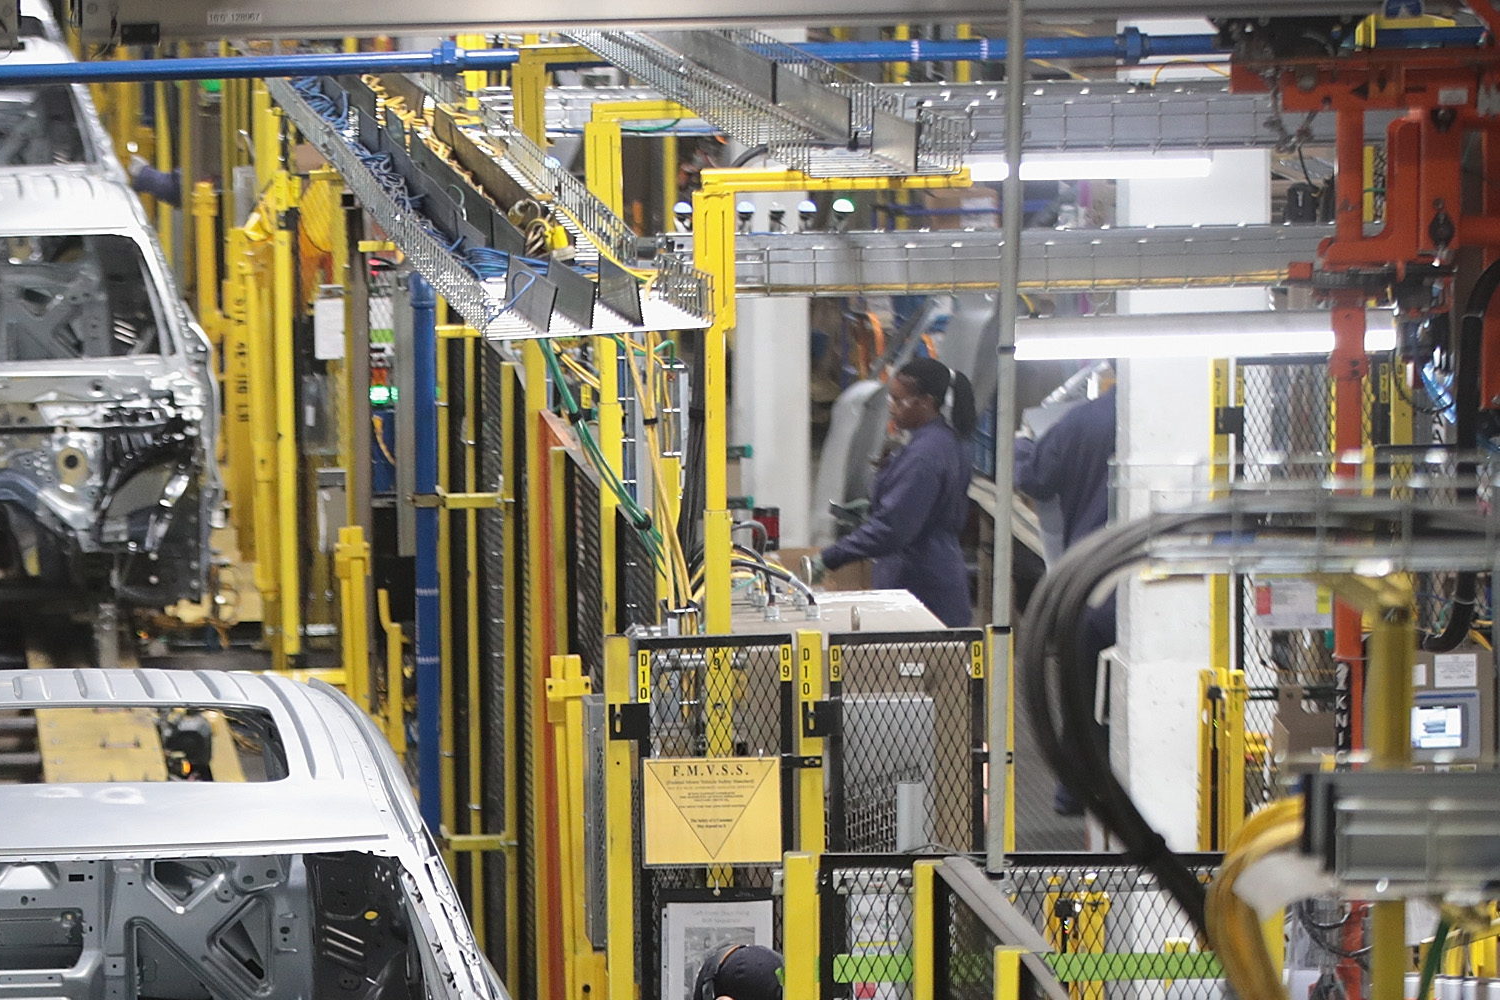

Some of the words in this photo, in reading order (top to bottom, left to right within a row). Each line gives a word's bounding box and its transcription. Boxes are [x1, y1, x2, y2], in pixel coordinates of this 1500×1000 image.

[782, 648, 790, 678] D9
[832, 649, 840, 678] D9
[974, 644, 981, 675] D8
[640, 653, 648, 700] D10
[672, 764, 749, 777] F.M.V.S.S.
